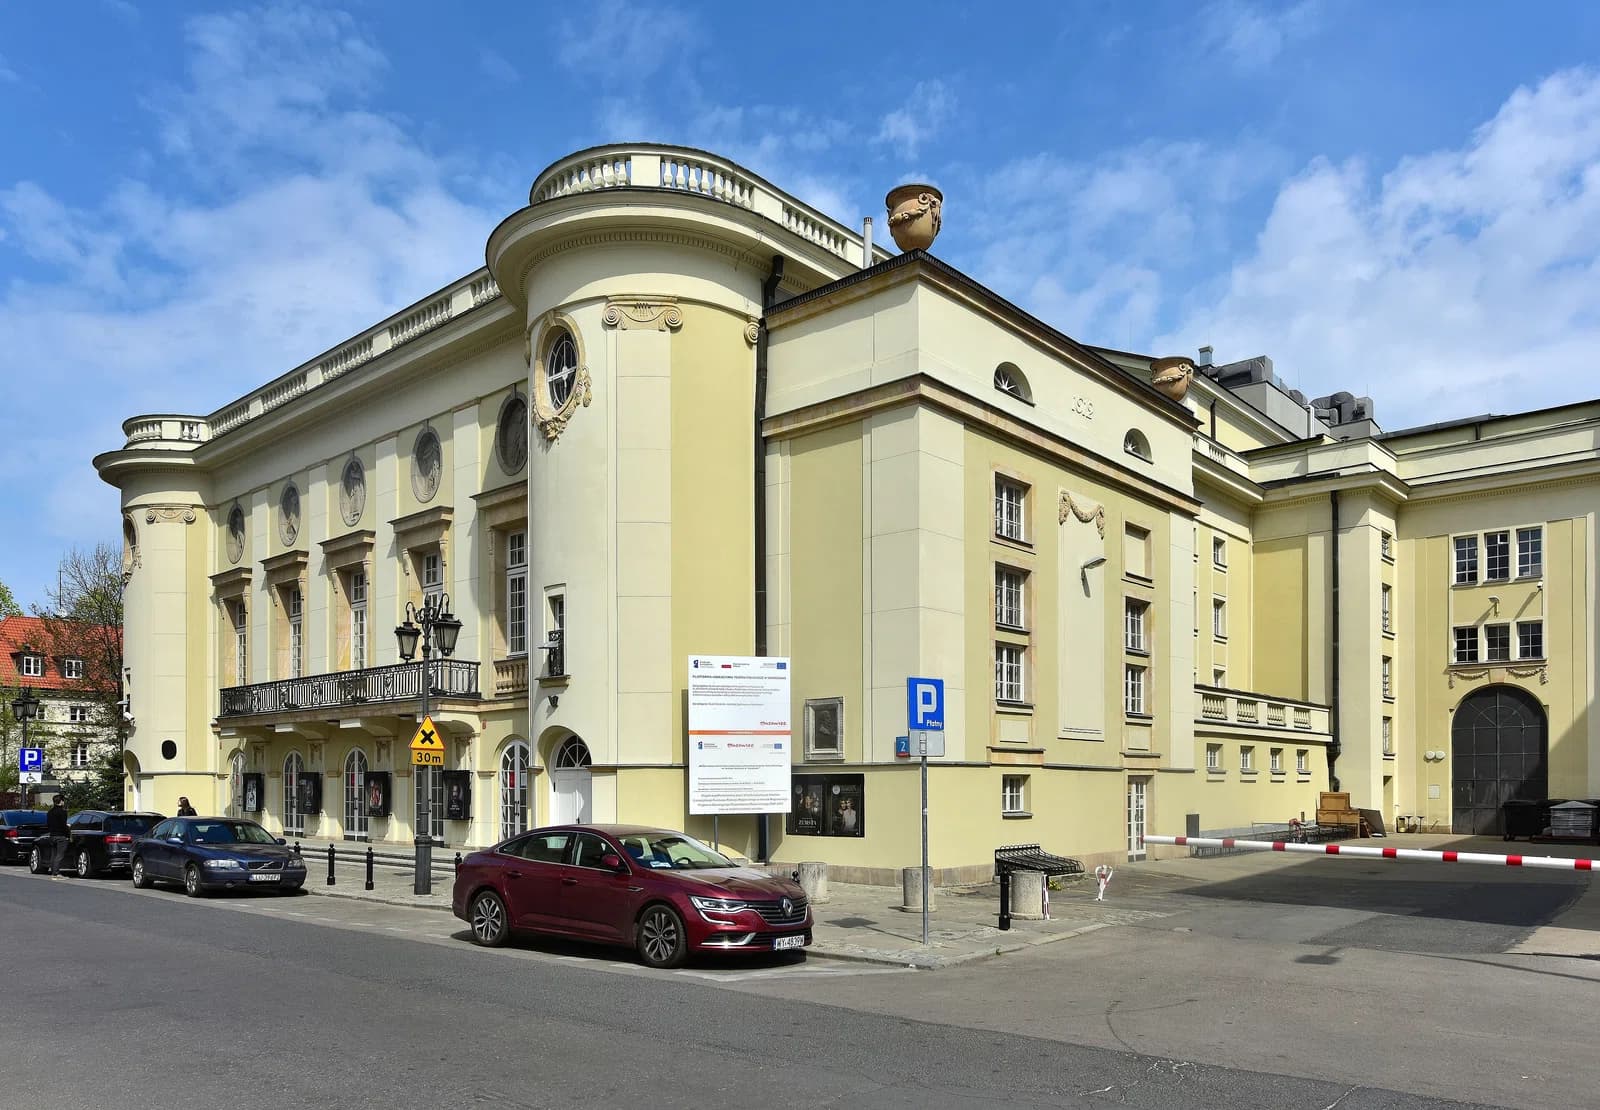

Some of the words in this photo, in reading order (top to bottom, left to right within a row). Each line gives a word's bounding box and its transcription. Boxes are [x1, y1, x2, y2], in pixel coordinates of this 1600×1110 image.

[917, 683, 937, 724] P
[926, 719, 943, 728] Płatny
[900, 741, 906, 752] 2
[25, 750, 38, 765] P
